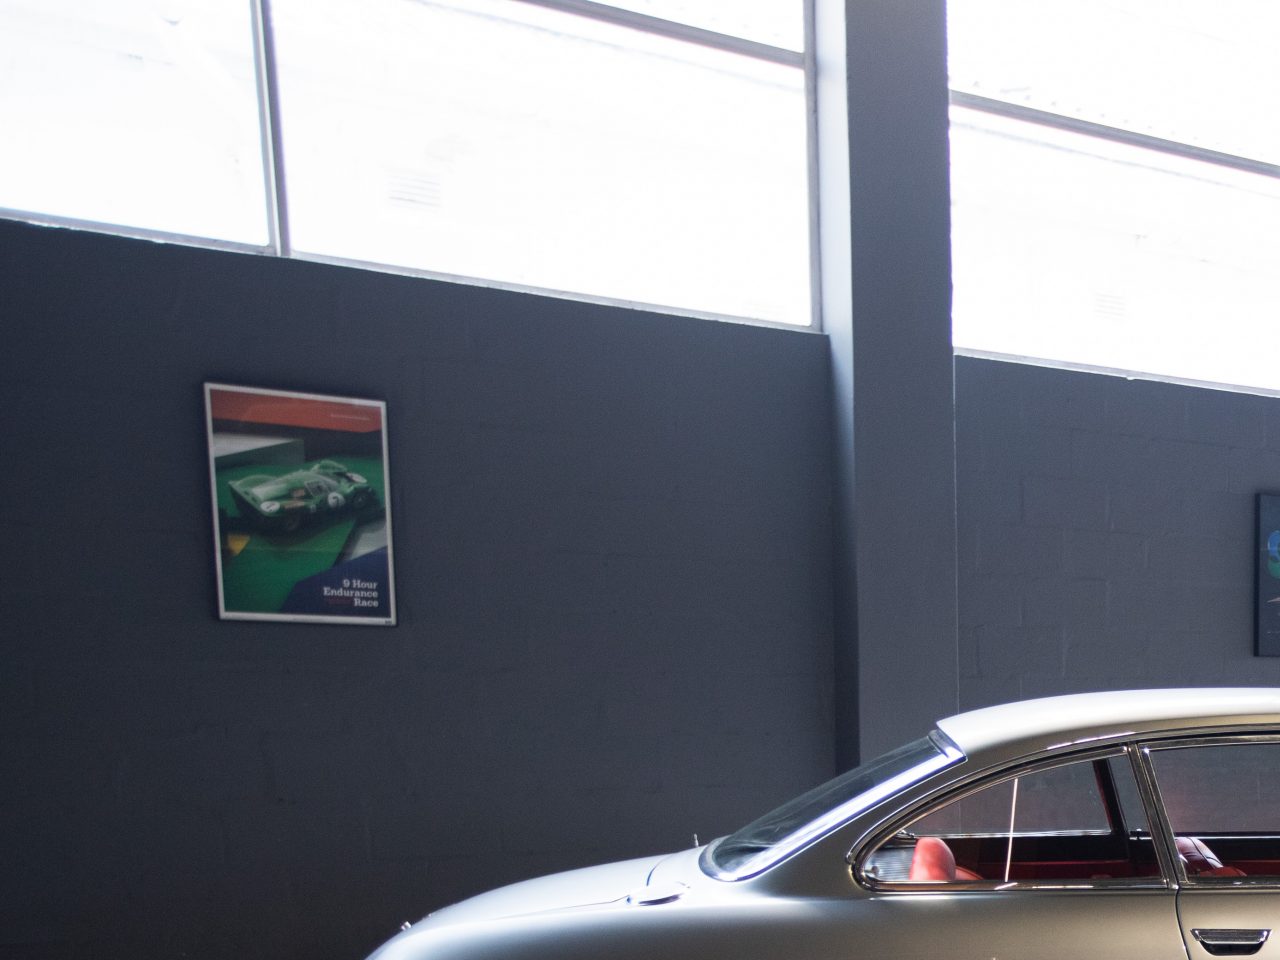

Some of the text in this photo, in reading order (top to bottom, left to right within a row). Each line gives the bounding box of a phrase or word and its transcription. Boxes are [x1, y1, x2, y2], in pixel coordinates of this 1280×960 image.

[343, 578, 378, 590] 9 Hour
[323, 586, 378, 598] Endurance
[354, 597, 379, 607] Race
